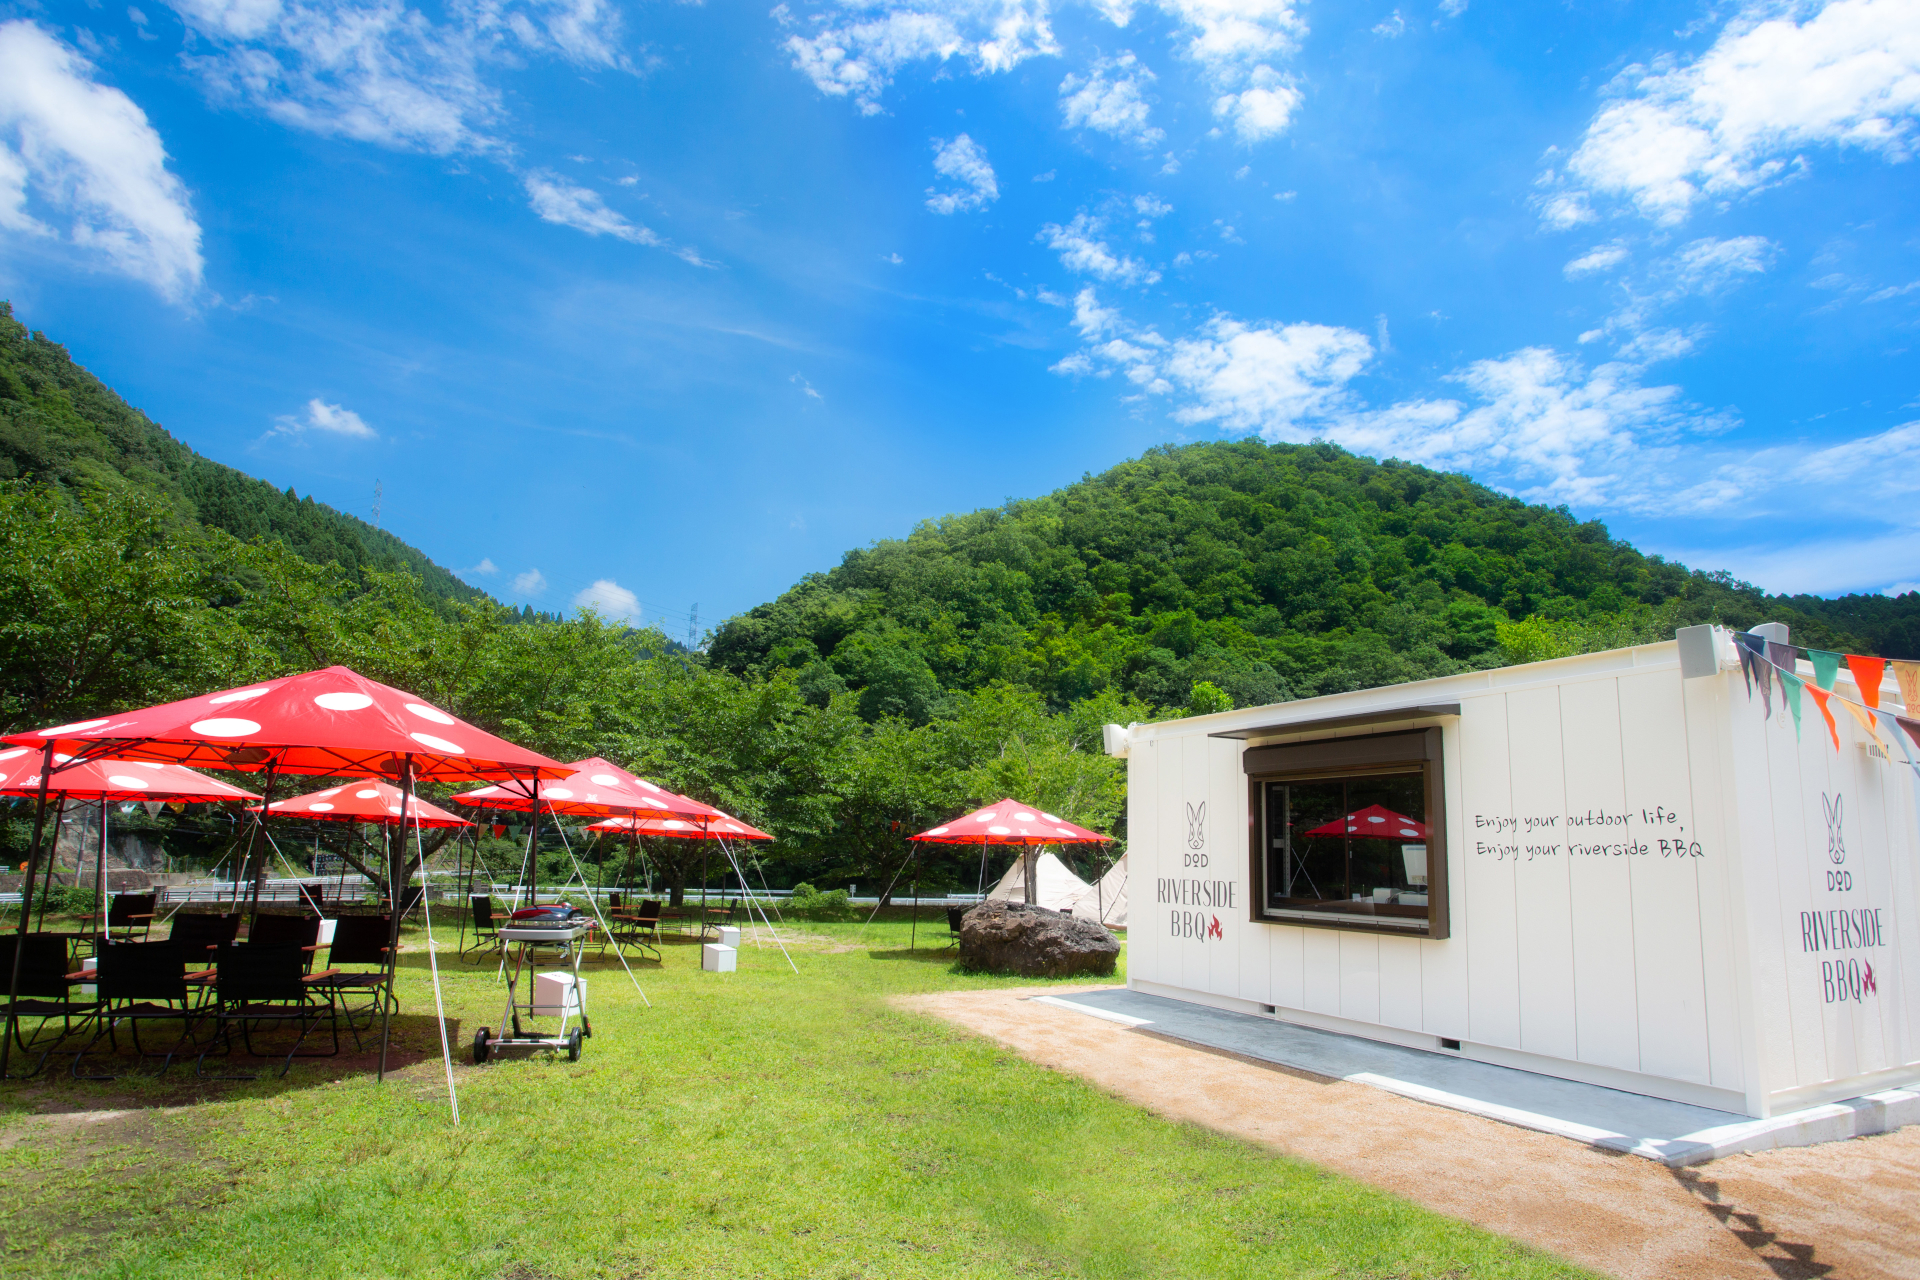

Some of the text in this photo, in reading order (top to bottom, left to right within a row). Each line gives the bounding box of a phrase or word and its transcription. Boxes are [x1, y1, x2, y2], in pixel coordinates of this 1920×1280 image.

[1475, 805, 1684, 833] Enjoy your outdoor life,
[1184, 853, 1209, 868] DOD
[1476, 838, 1705, 861] Enjoy your riverside BBQ
[1157, 878, 1238, 909] RIVERSIDE
[1826, 870, 1853, 892] DOD
[1171, 910, 1206, 943] BBQ
[1800, 908, 1886, 952] RIVERSIDE
[1822, 958, 1862, 1004] BBQ
